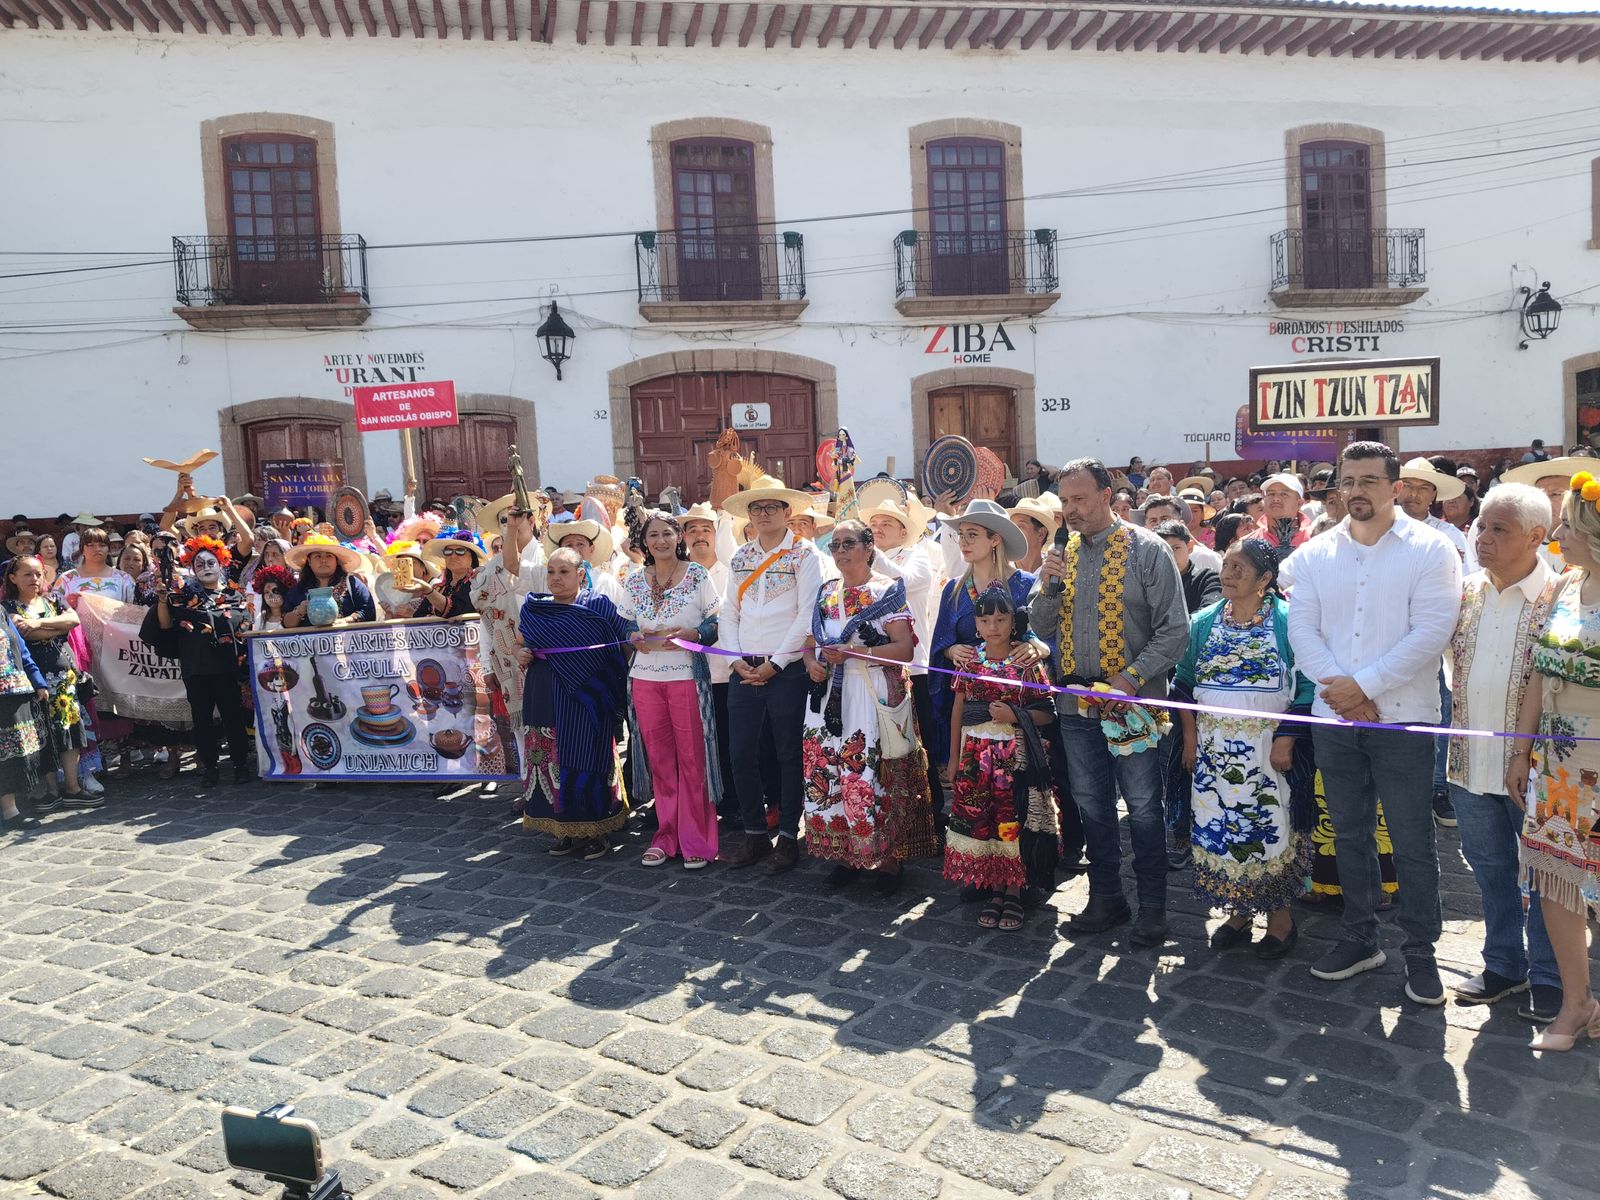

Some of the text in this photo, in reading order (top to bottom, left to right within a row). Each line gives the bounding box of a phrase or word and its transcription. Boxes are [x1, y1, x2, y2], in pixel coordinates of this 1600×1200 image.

[1269, 320, 1405, 335] BORDADOS Y DESHILADOS
[923, 322, 1016, 353] ZIBA
[1291, 335, 1380, 353] CRISTI
[323, 352, 425, 366] ARTE Y NOVEDADES
[954, 353, 991, 364] HOME
[372, 388, 435, 401] ARTESANOS
[1259, 372, 1430, 420] TZIN TZUN TZAN
[399, 402, 411, 411] DE
[1041, 398, 1071, 411] 32-B
[361, 410, 452, 425] SAN NICOLÁS OBISPO
[593, 409, 607, 420] 32
[270, 474, 341, 483] SANTA CLARA
[281, 485, 300, 493] DEL
[260, 625, 480, 657] UNIÓN DE ARTESANOS D
[332, 655, 410, 681] CAPULA
[343, 751, 438, 773] UNIAMICH
